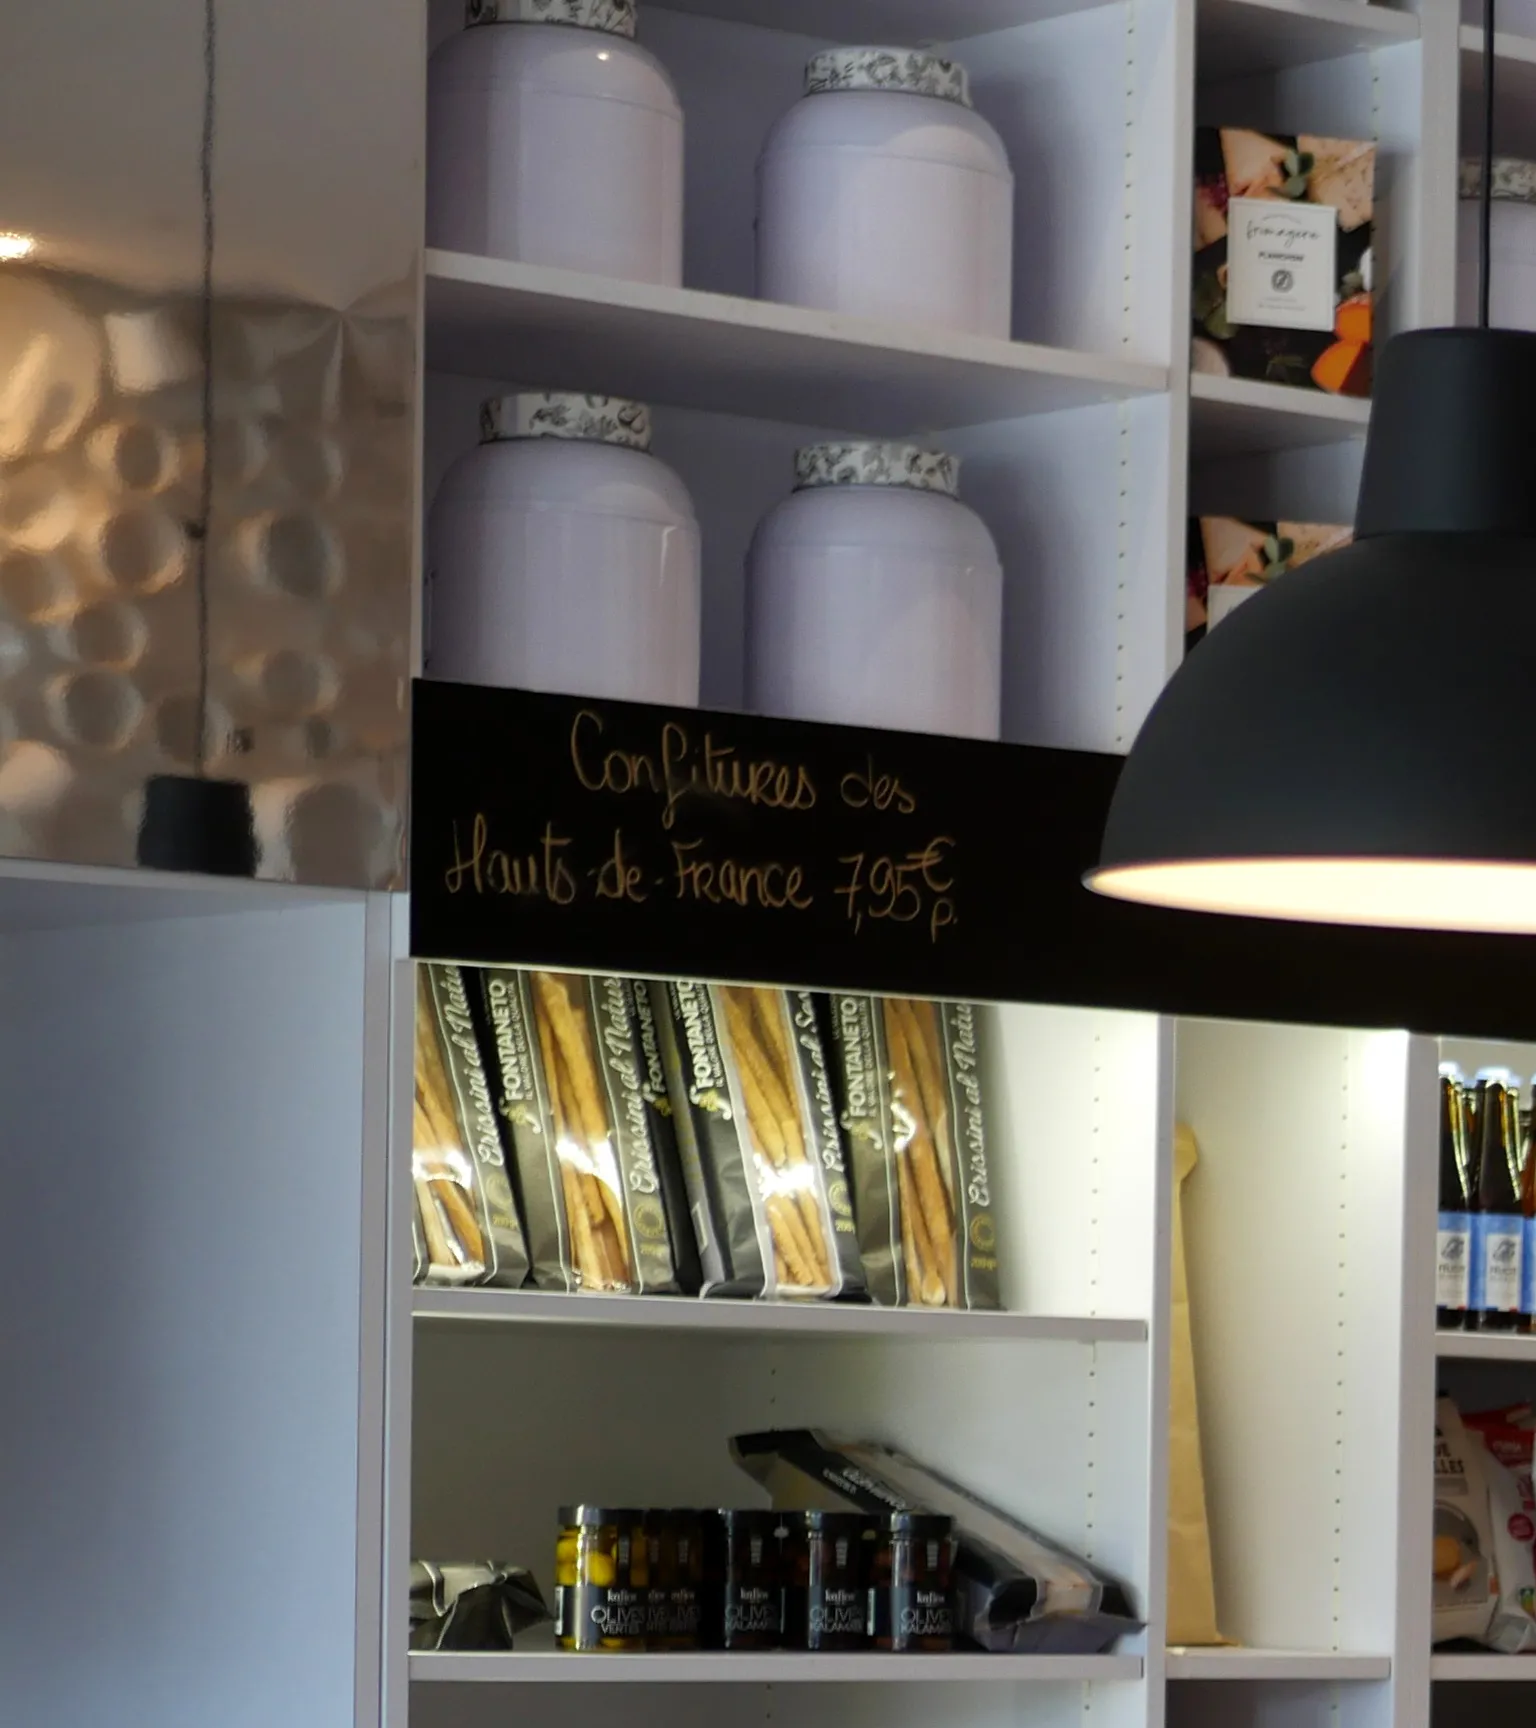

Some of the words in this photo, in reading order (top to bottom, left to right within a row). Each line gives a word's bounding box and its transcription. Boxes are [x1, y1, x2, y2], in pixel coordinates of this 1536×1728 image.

[572, 711, 815, 828] Confitures
[841, 753, 915, 814] des
[489, 978, 524, 1102] FONTANETO
[840, 999, 866, 1118] FONTANETO
